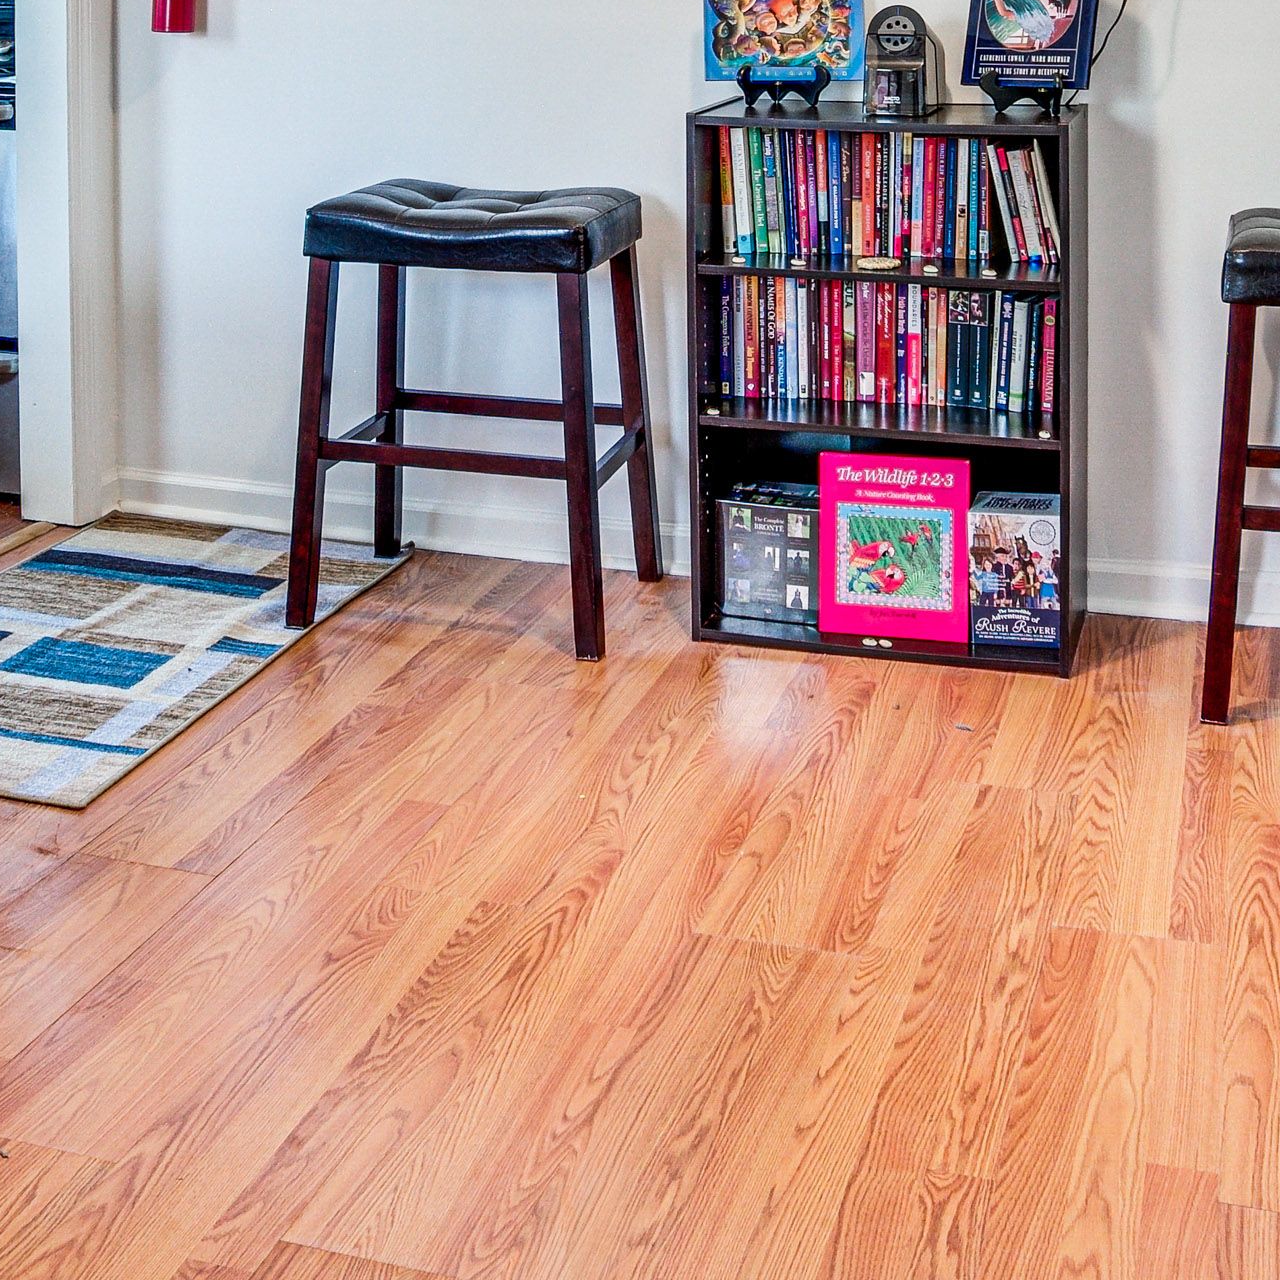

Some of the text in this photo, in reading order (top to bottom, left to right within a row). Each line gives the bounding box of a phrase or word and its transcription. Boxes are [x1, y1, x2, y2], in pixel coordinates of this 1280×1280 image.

[837, 467, 862, 481] The
[866, 468, 918, 488] Wildlife
[864, 490, 887, 498] Nature
[887, 491, 916, 502] Counting
[917, 494, 935, 502] Book
